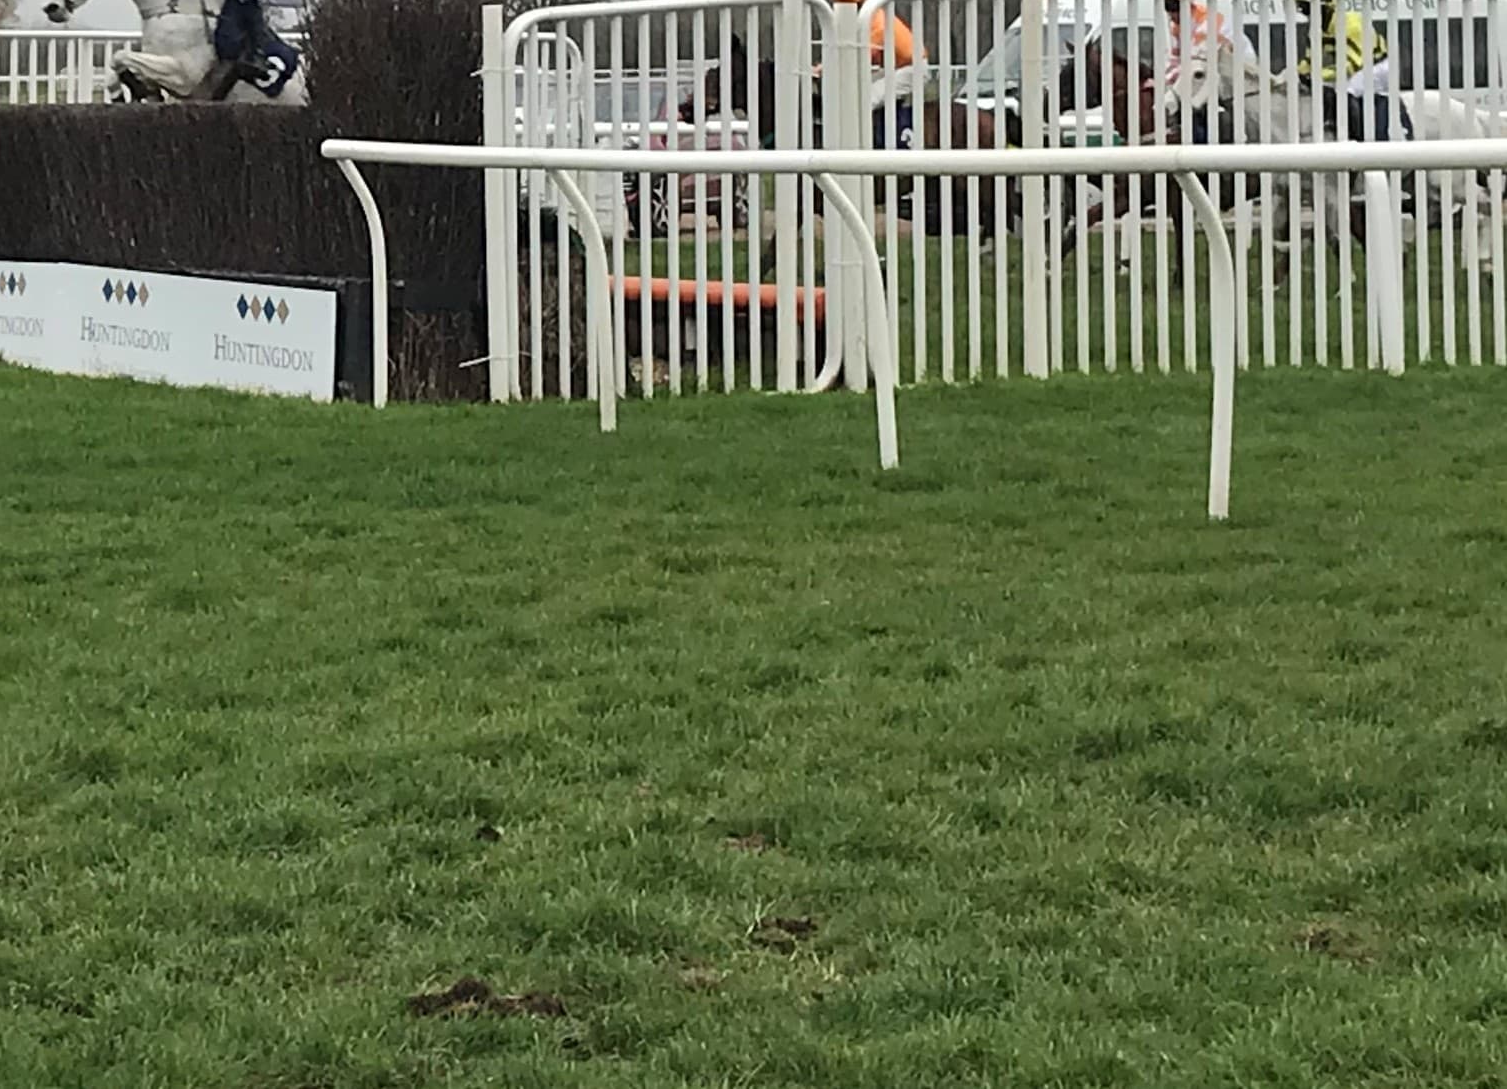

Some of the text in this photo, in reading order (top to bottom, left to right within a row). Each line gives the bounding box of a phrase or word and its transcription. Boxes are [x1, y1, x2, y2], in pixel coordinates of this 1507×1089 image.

[1232, 0, 1276, 14] IGH
[255, 55, 286, 88] 3
[80, 316, 172, 351] HUNTINGDON
[213, 333, 313, 372] HUNTINGDON
